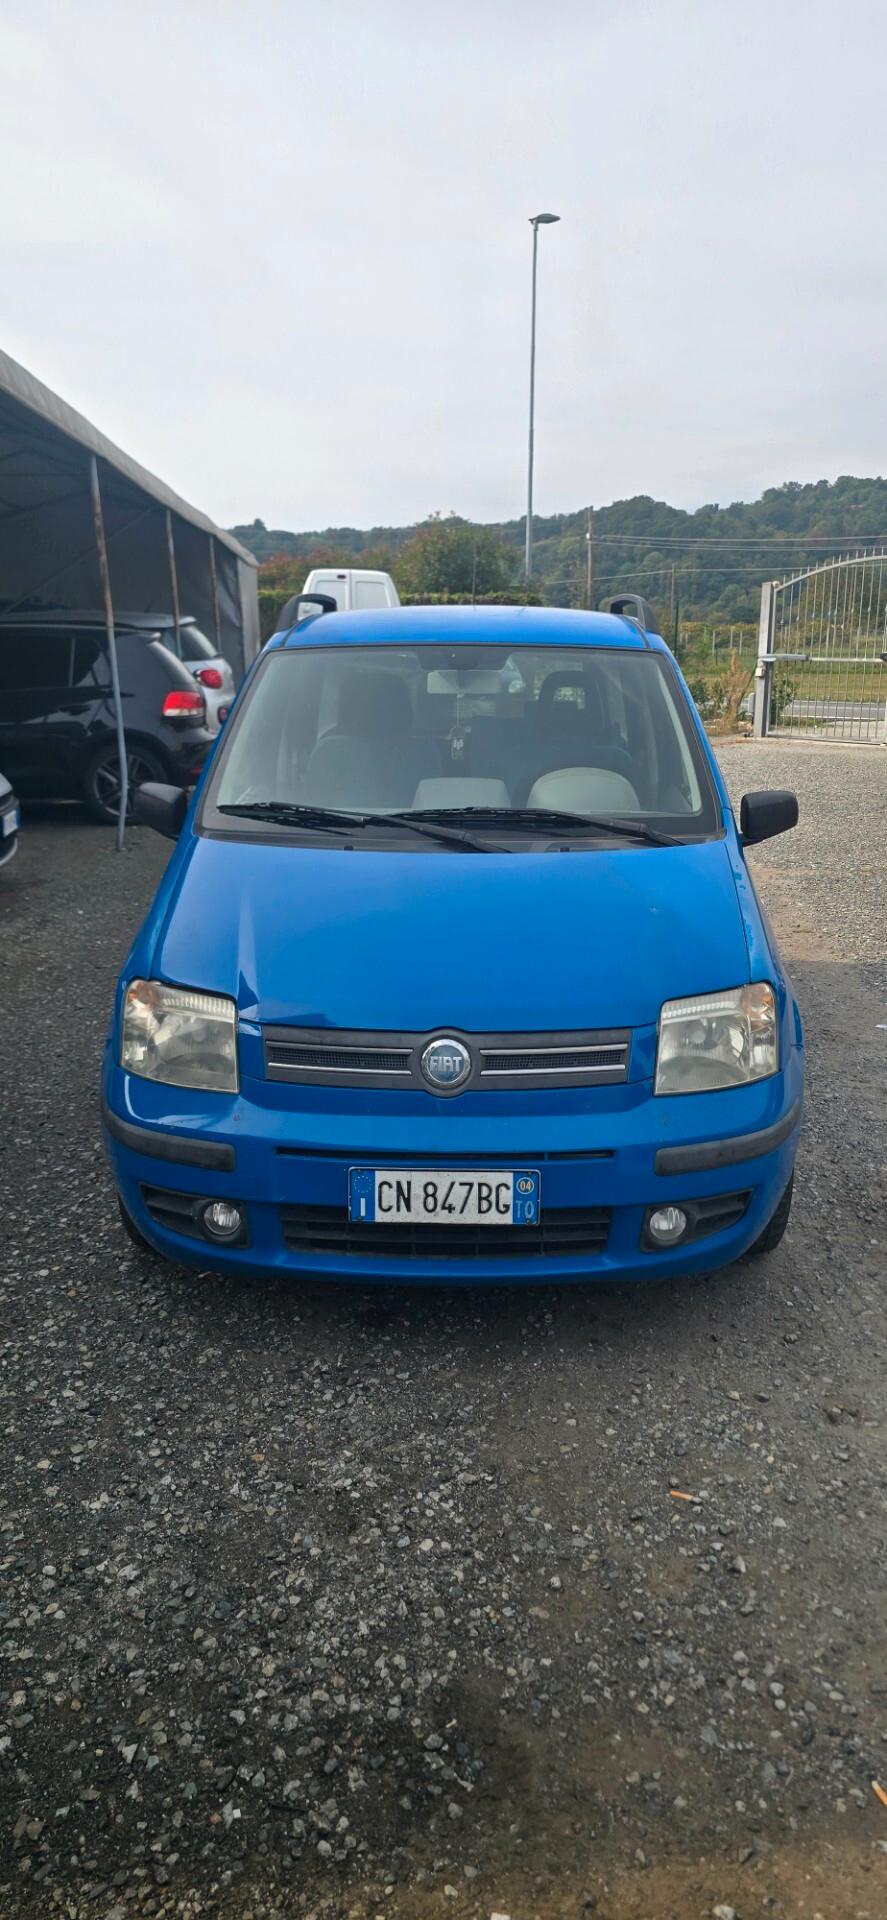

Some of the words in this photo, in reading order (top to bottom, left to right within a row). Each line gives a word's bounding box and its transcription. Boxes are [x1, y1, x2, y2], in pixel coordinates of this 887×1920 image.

[430, 1056, 462, 1072] FIAT
[519, 1182, 532, 1192] 04
[377, 1180, 412, 1213] CN
[422, 1181, 512, 1214] 847BG
[360, 1197, 366, 1217] I
